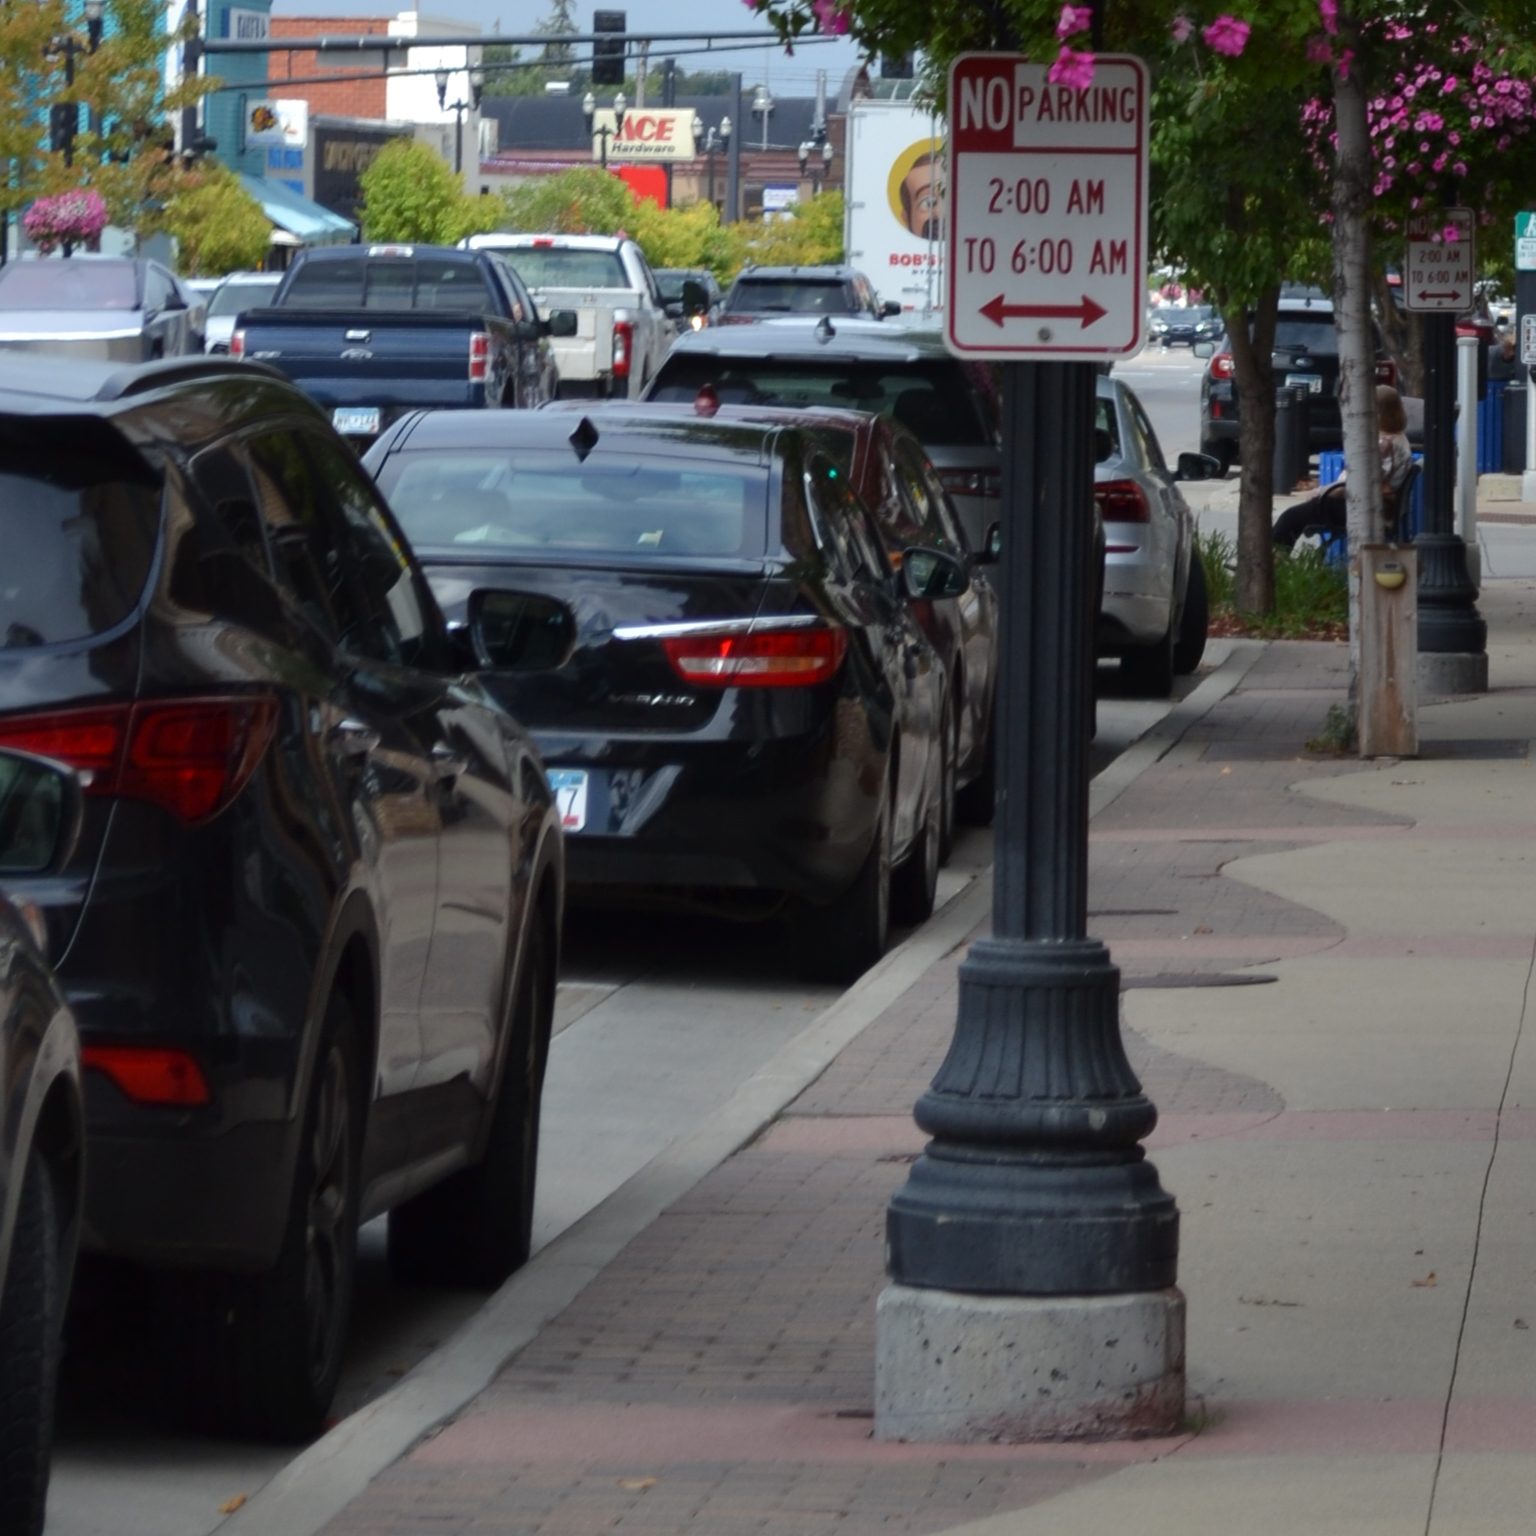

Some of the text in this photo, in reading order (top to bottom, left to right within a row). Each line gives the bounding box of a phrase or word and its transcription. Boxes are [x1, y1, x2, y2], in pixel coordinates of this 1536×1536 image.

[960, 77, 1135, 131] NO PARKING
[613, 115, 677, 142] ACE
[611, 142, 676, 154] Hardware
[988, 178, 1105, 215] 2:00 AM
[889, 252, 938, 268] BOB'S
[964, 237, 1128, 275] TO 6:00 AM
[1420, 250, 1460, 264] 2:00 AM
[1412, 270, 1469, 284] TO 6:00 AM
